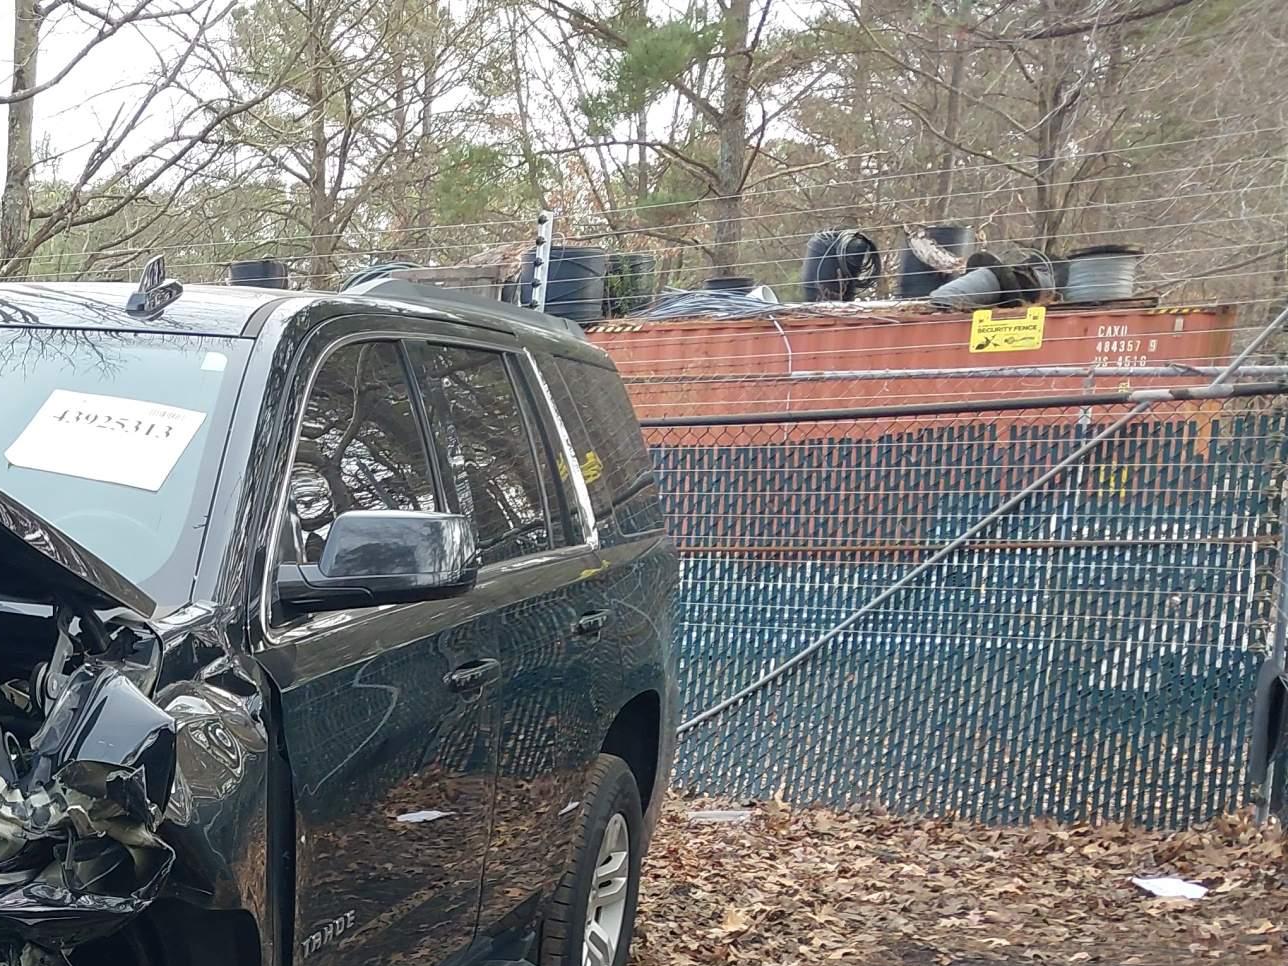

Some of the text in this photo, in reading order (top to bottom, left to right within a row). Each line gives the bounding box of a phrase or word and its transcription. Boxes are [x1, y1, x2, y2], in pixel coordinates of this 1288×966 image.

[977, 326, 1013, 334] SECURITY
[1013, 324, 1038, 332] FENCE
[1149, 339, 1158, 352] 9
[52, 409, 175, 439] 43925313
[301, 909, 357, 959] TAHOE
